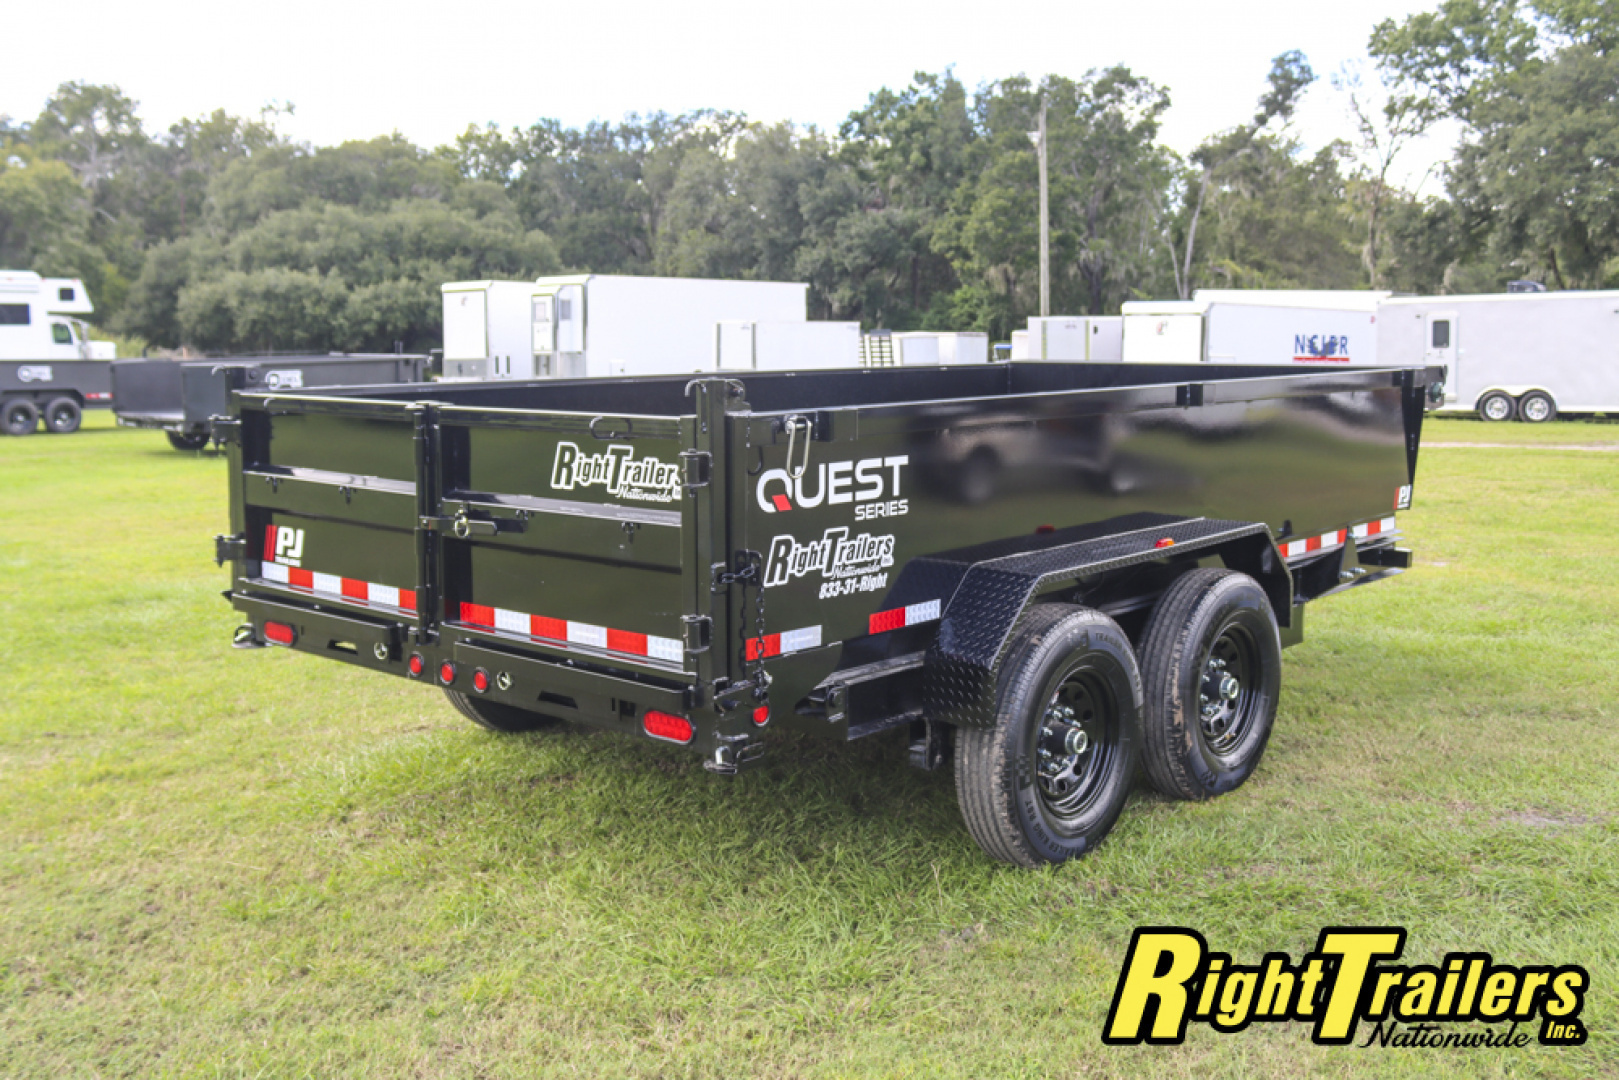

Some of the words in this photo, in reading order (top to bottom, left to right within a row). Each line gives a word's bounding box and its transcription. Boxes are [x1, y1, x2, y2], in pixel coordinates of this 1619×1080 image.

[756, 455, 909, 513] QUEST
[855, 499, 909, 521] SERIES
[276, 525, 305, 558] PJ
